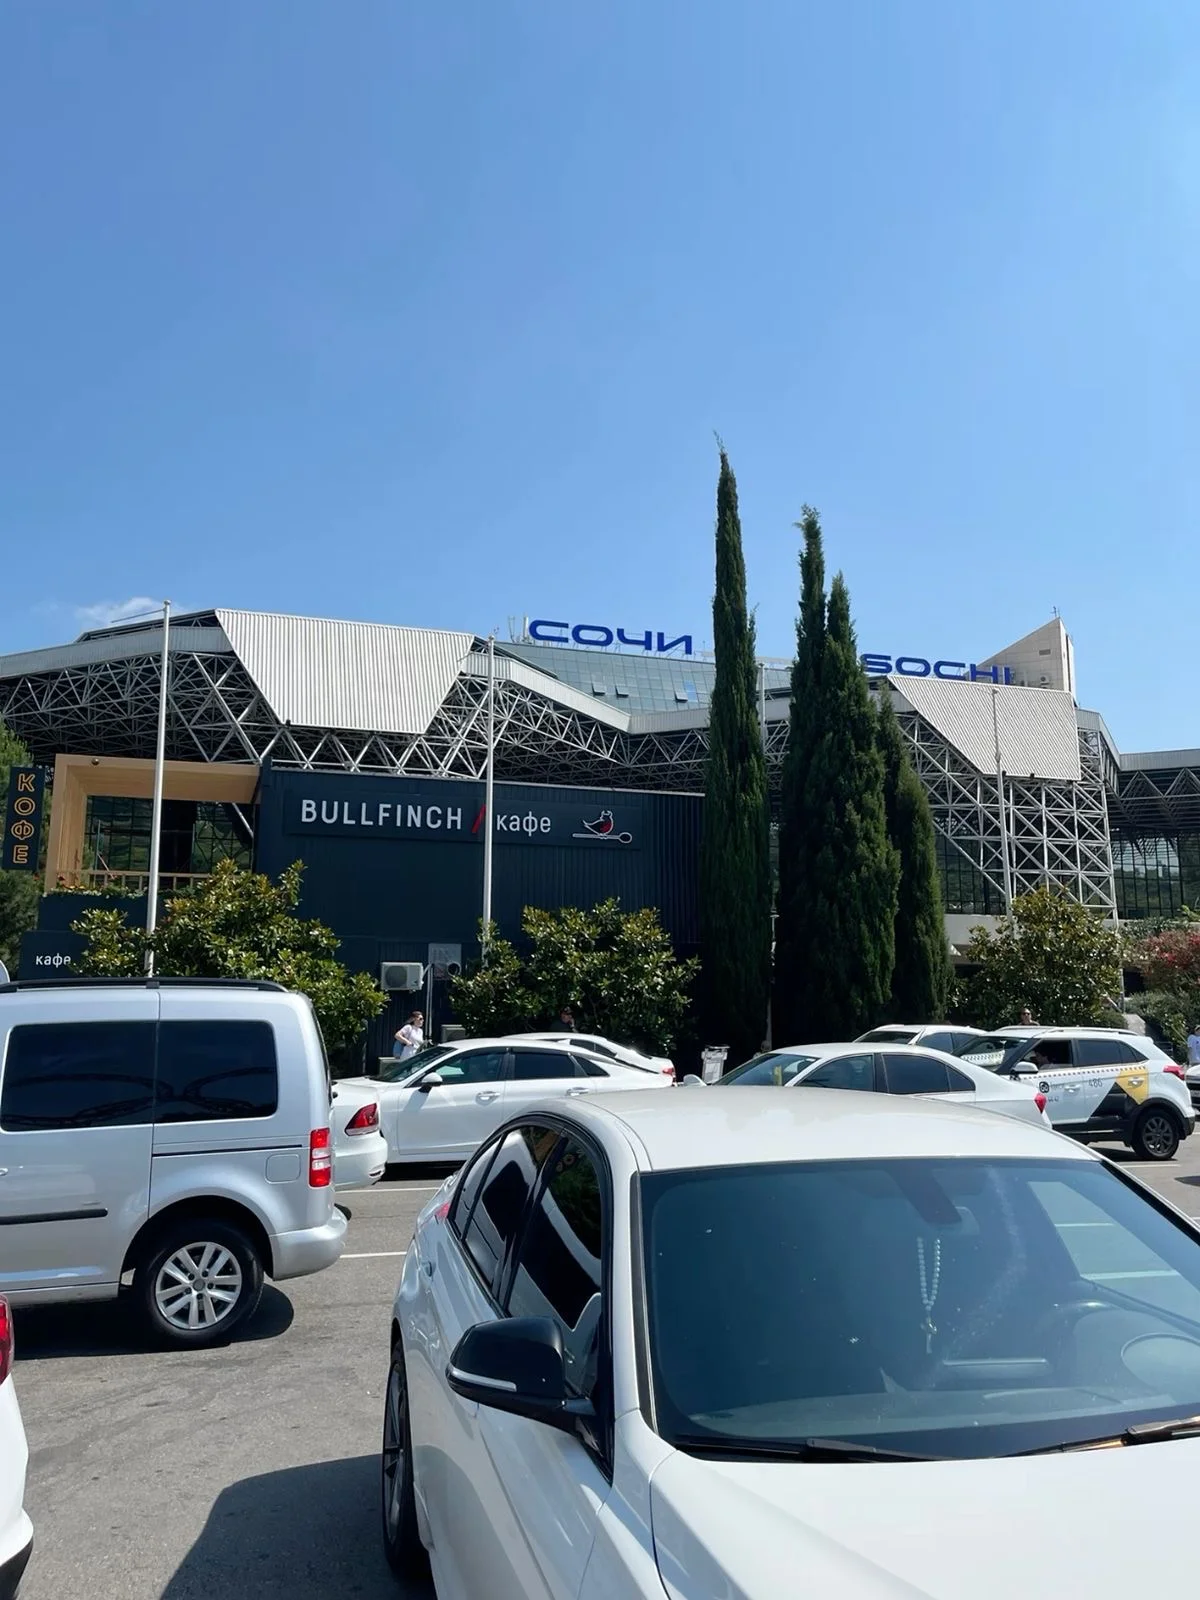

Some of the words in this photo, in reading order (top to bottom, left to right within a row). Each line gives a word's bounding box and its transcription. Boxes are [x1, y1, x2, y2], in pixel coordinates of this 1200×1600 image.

[528, 619, 692, 655] СОЧИ
[860, 653, 1011, 686] SOCHI
[11, 773, 36, 864] КОФЕ
[301, 799, 462, 830] BULLFINCH
[496, 811, 551, 837] кафе
[35, 952, 72, 969] кафе
